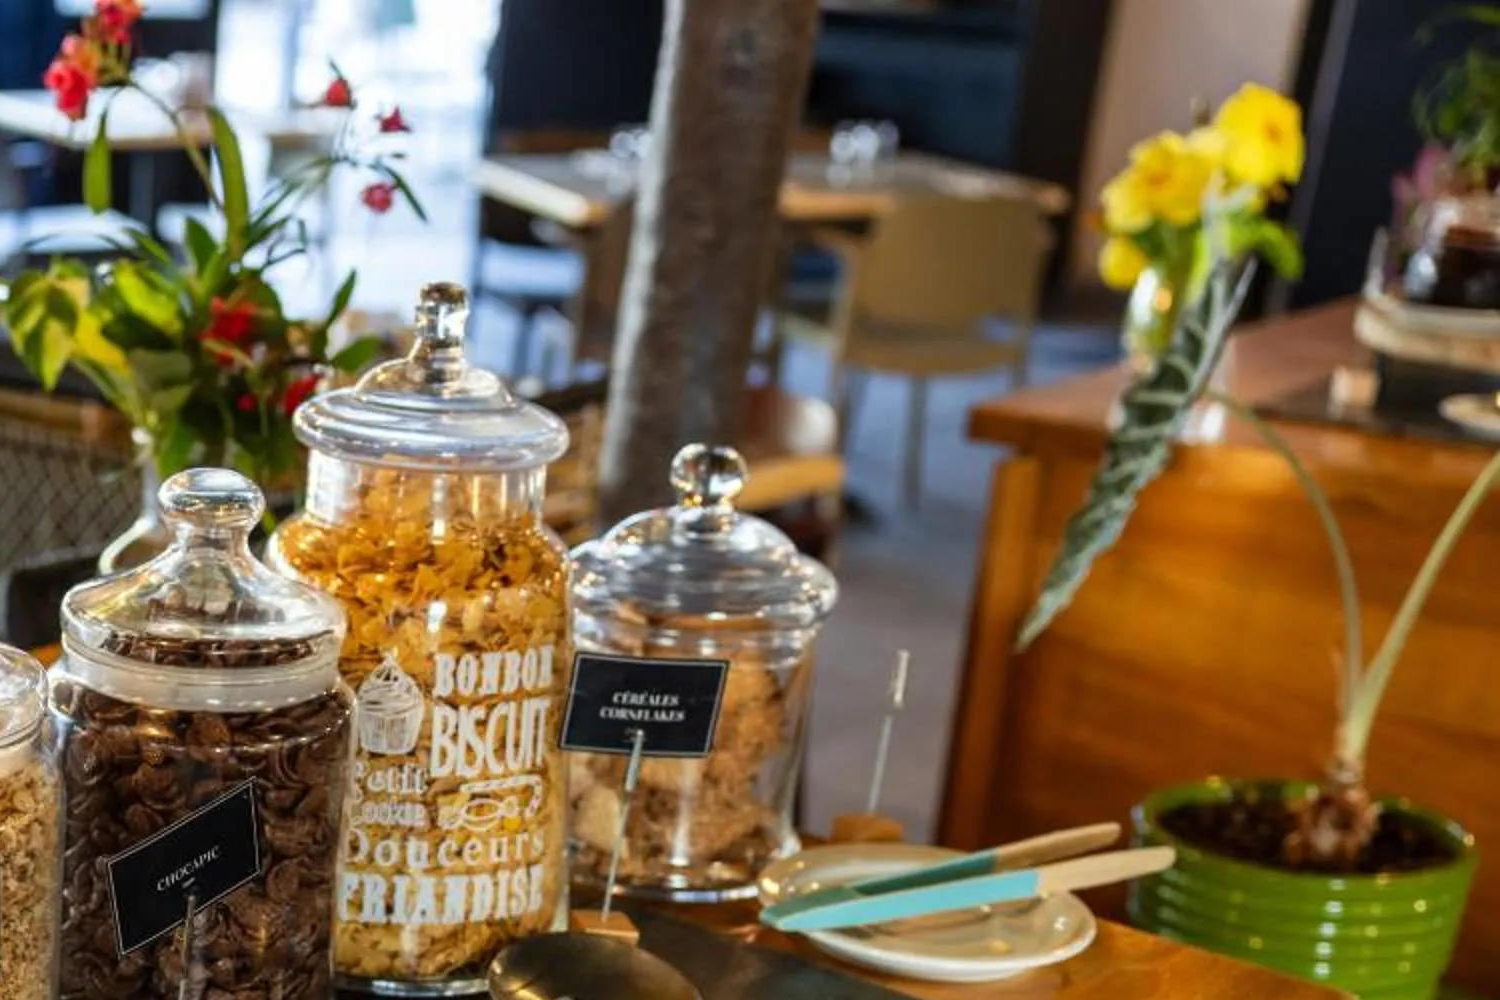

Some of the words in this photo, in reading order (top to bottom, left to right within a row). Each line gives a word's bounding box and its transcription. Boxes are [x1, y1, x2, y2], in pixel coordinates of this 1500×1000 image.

[430, 697, 551, 777] BISCUIT
[599, 706, 685, 722] CORNFLAKES
[156, 844, 221, 892] CHOCAPIC
